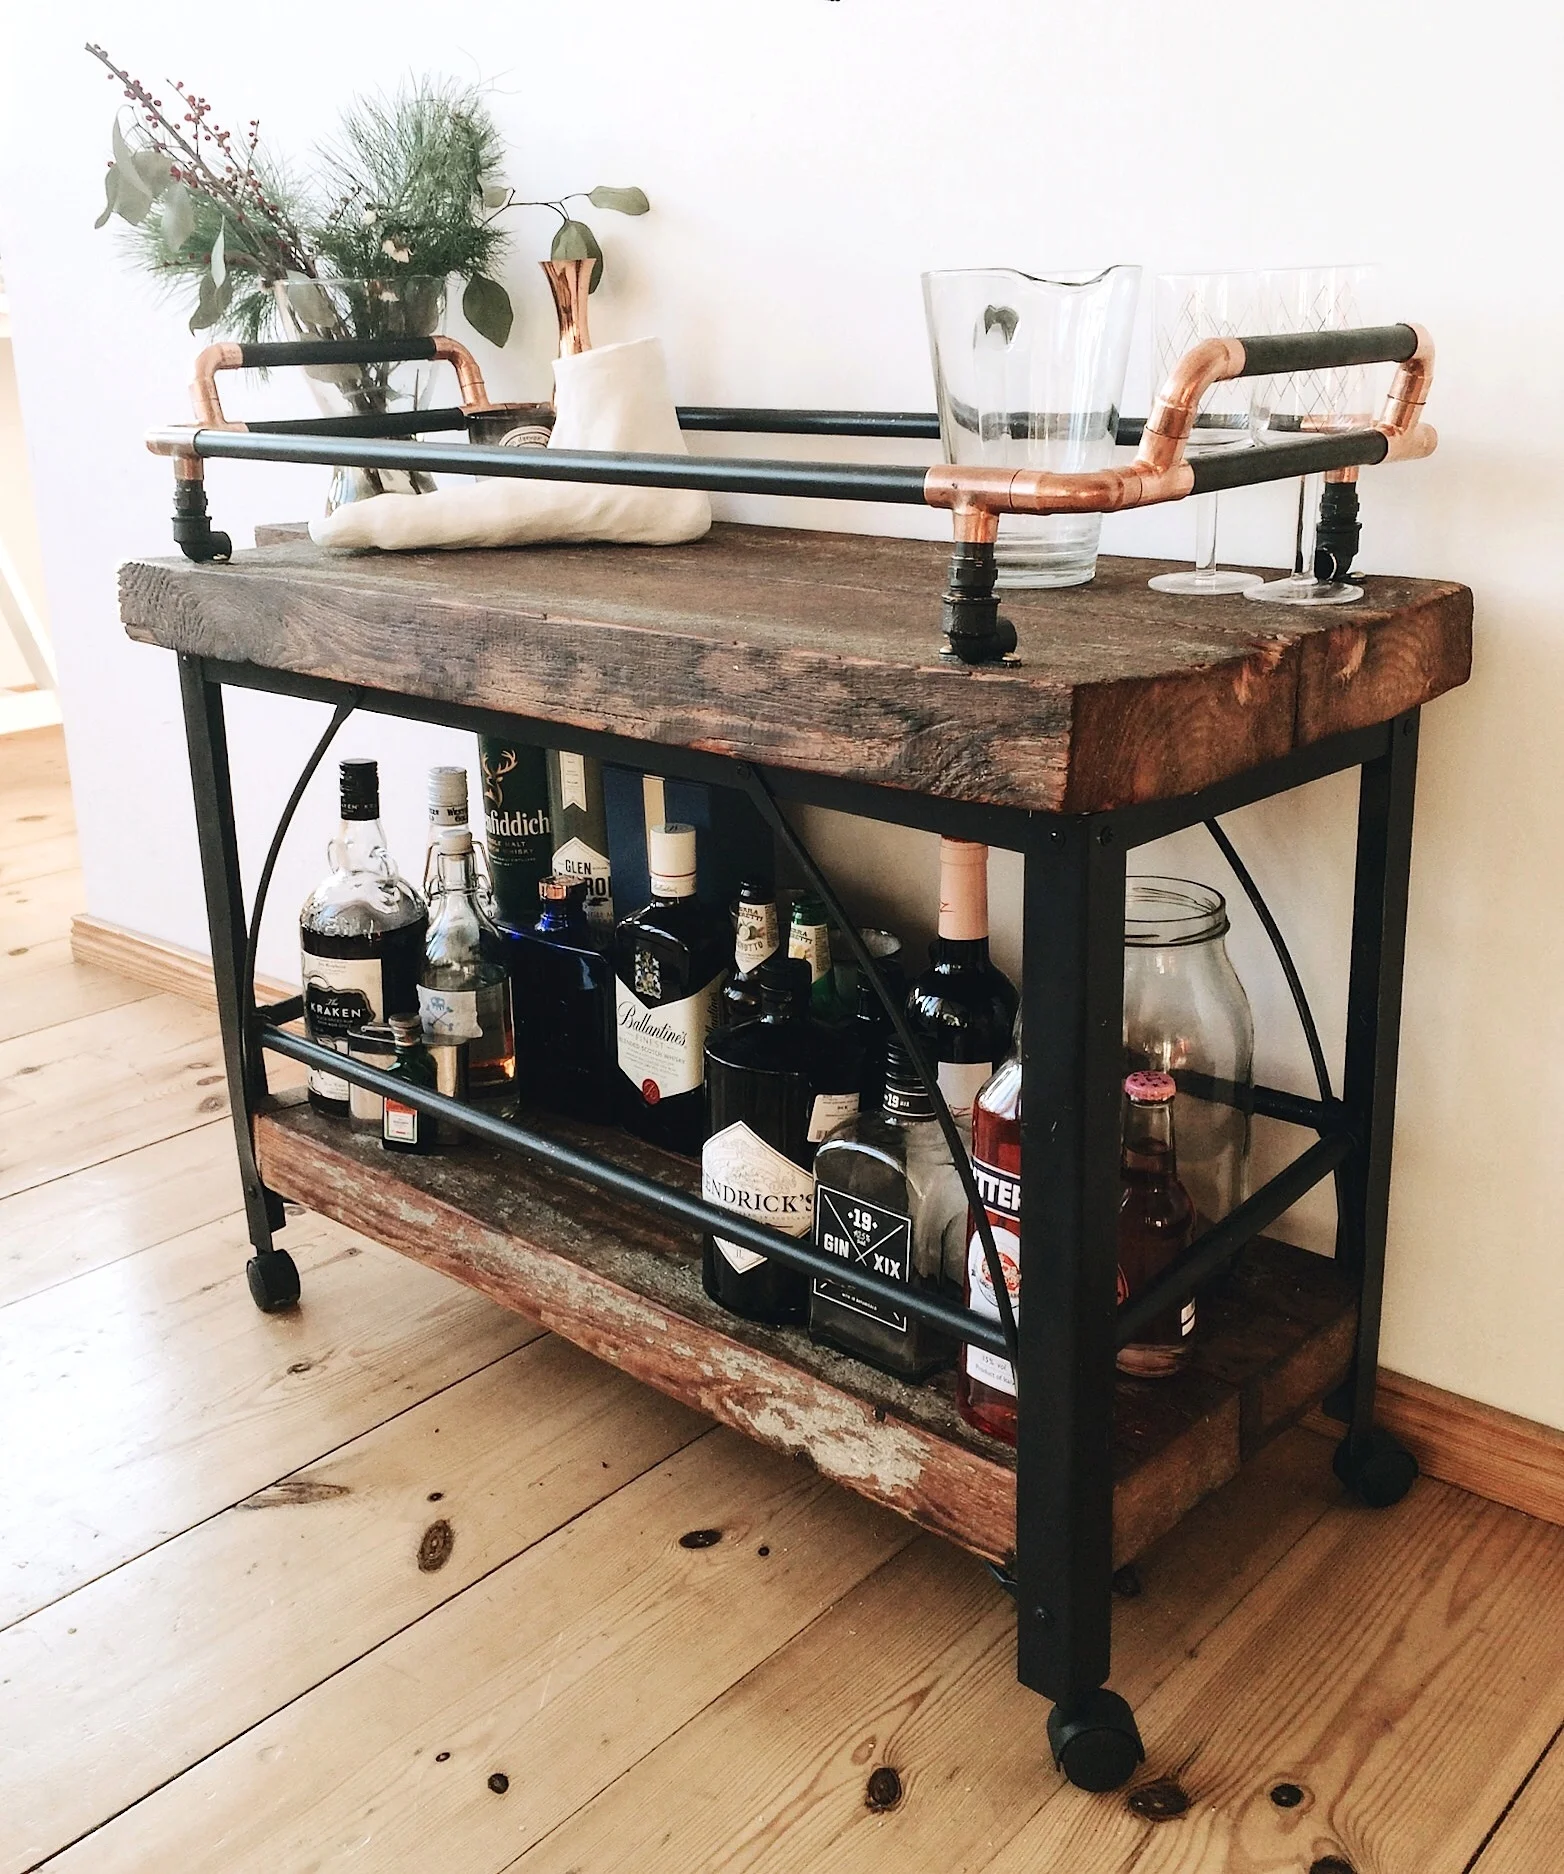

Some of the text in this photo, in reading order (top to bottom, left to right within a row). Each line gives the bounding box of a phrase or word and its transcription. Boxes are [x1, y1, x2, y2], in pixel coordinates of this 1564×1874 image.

[565, 859, 593, 876] GLEN
[310, 1001, 361, 1019] KRAKEN
[618, 1001, 688, 1046] Ballantine's
[887, 1093, 900, 1108] 19
[853, 1207, 873, 1232] 19
[823, 1233, 850, 1259] GIN
[873, 1252, 901, 1280] XIX
